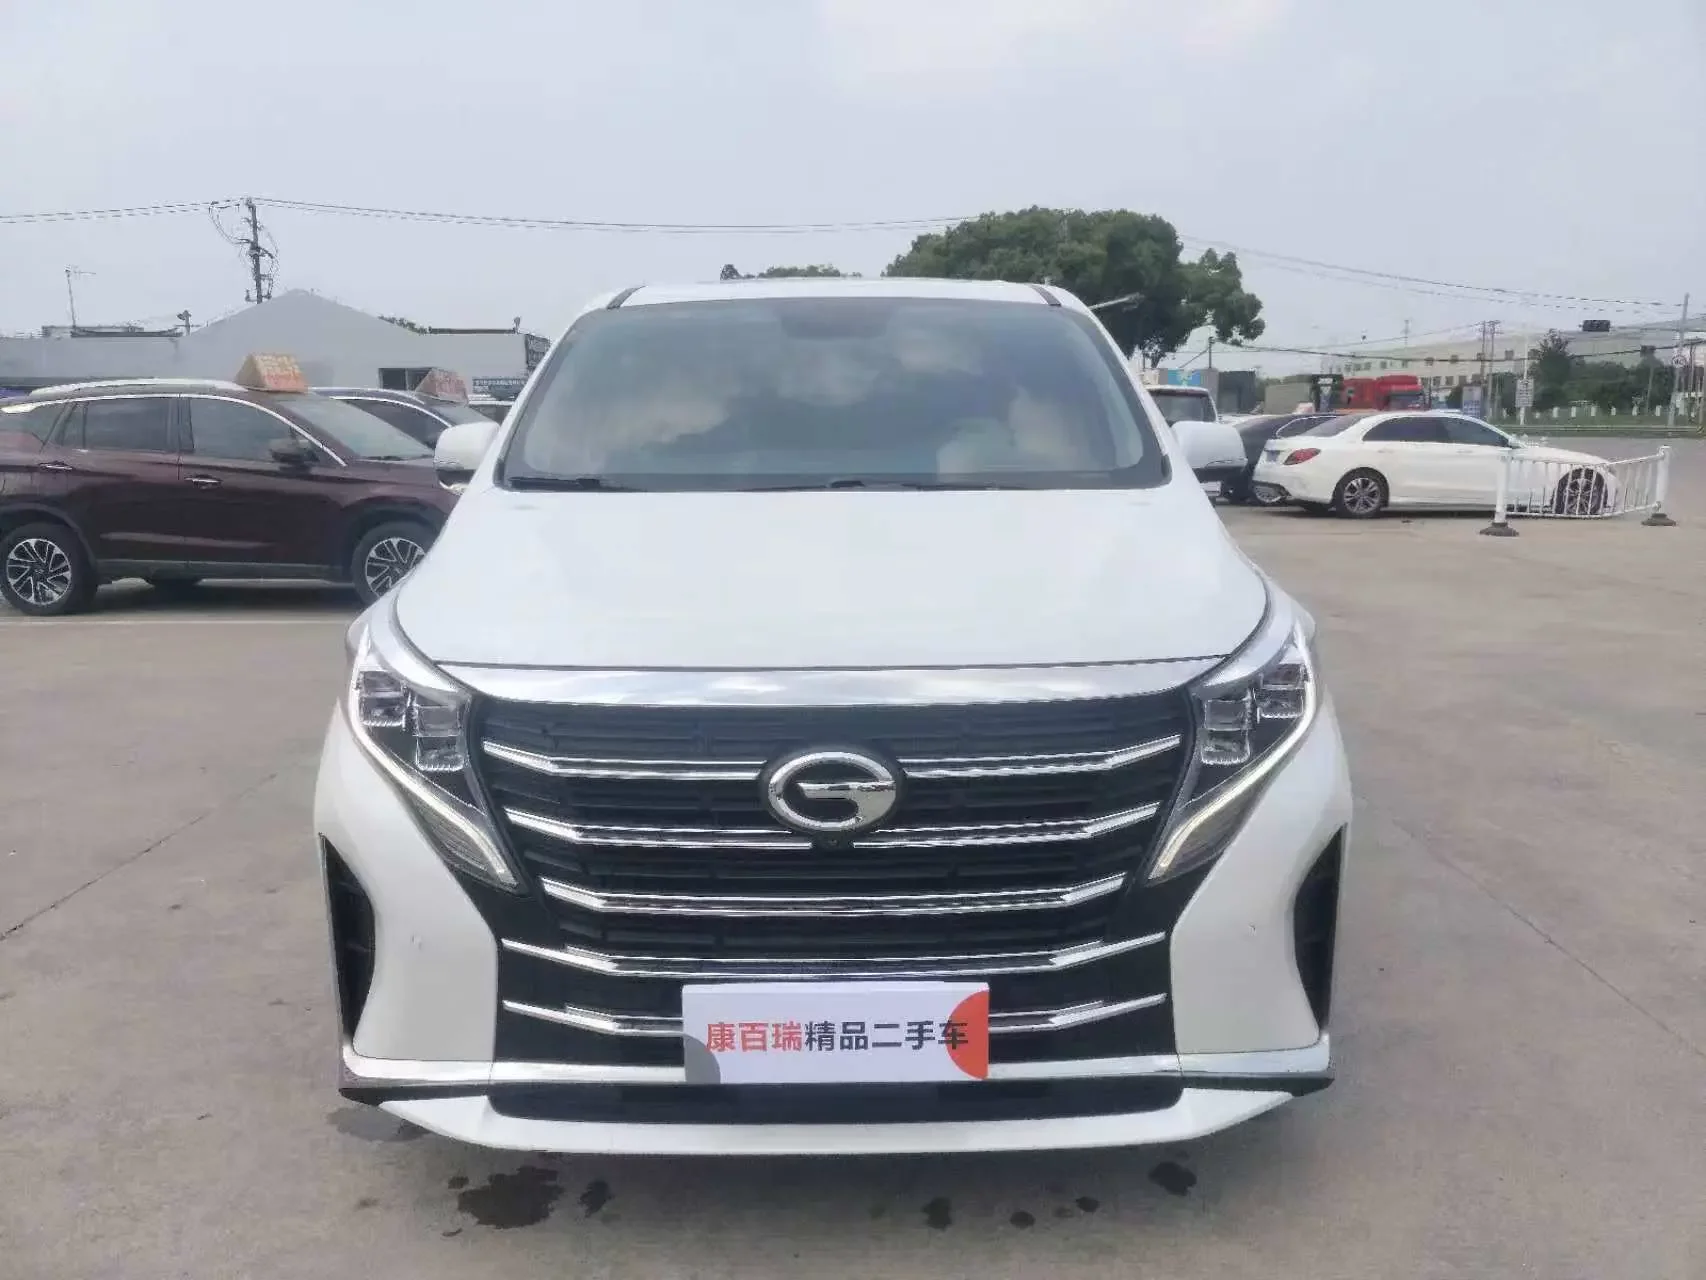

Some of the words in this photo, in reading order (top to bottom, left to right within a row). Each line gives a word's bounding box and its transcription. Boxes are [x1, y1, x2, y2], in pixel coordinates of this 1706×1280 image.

[706, 1020, 969, 1052] 康百瑞精品二手车
